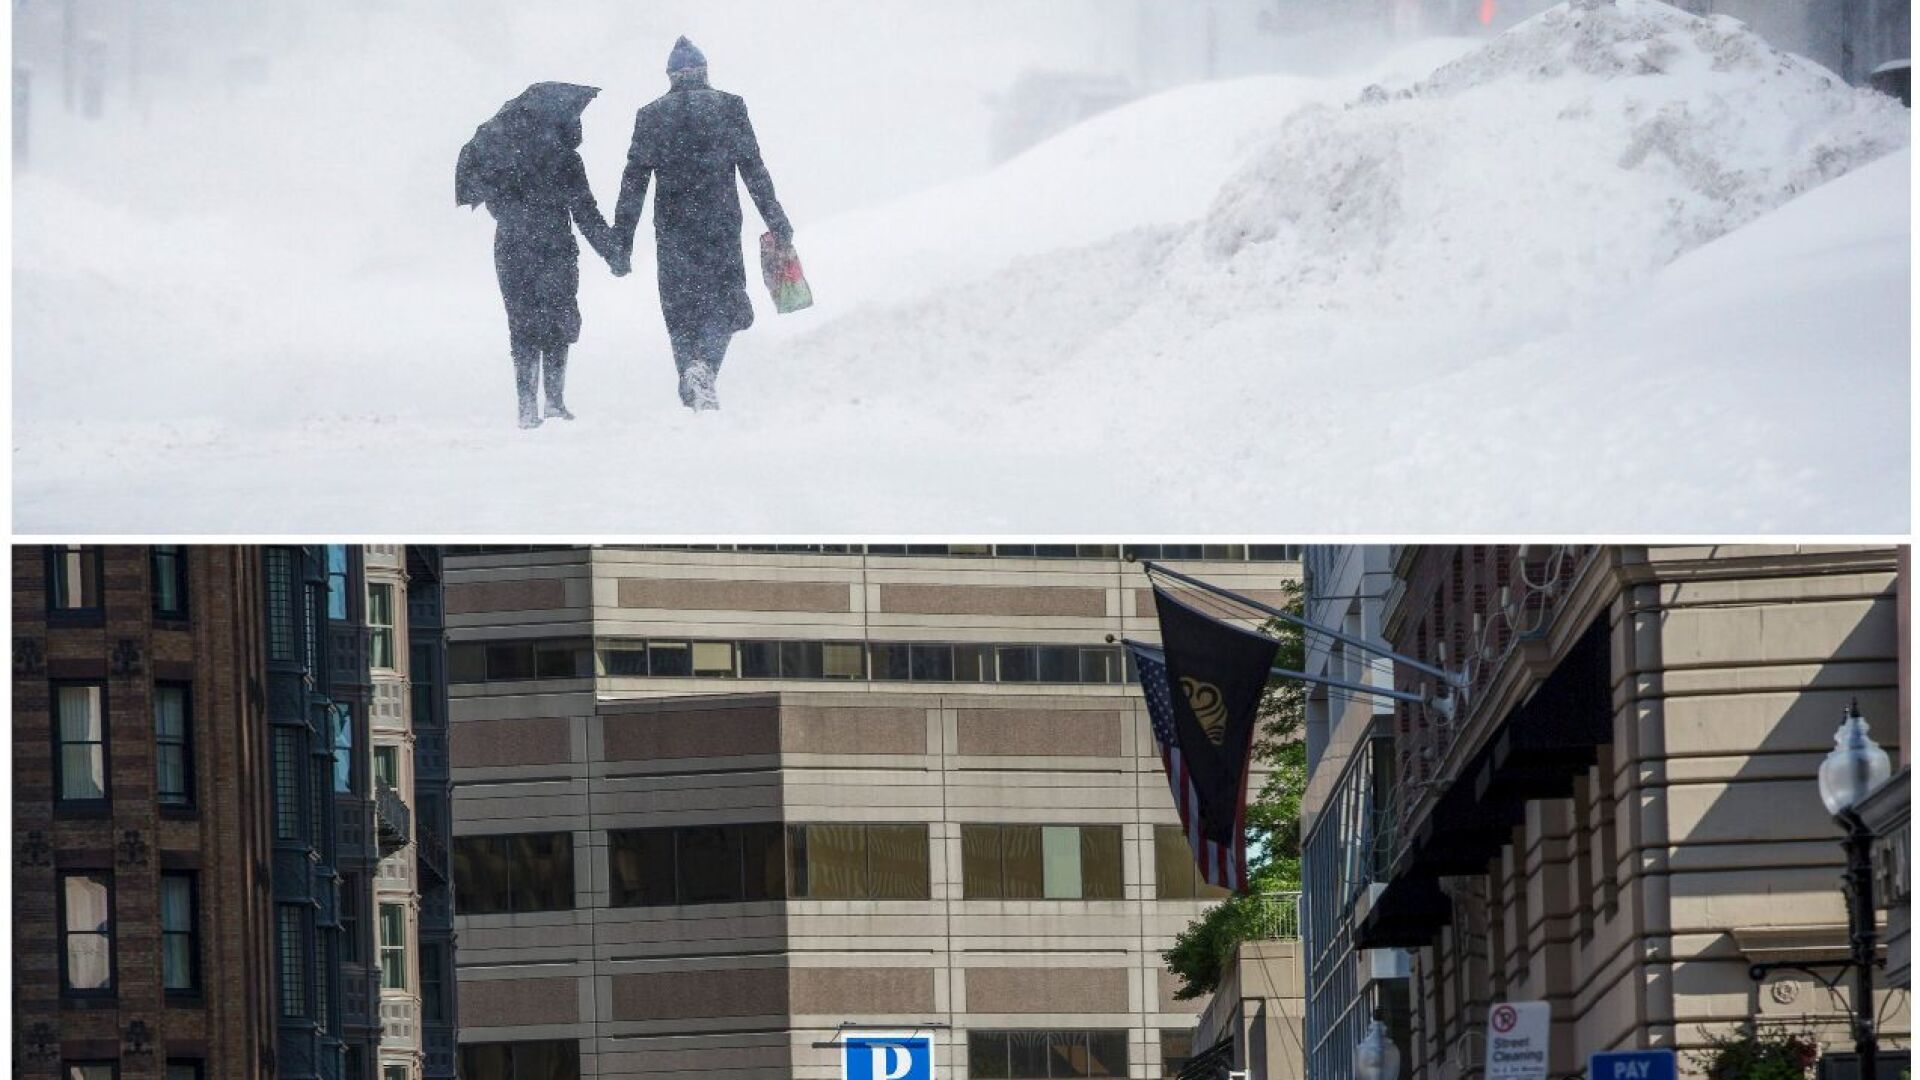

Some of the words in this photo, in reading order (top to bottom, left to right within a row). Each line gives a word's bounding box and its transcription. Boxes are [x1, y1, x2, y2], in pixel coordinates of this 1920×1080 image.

[1494, 1037, 1530, 1050] Street
[865, 1042, 913, 1080] P
[1492, 1051, 1544, 1063] Cleaning
[1614, 1060, 1651, 1079] PAY
